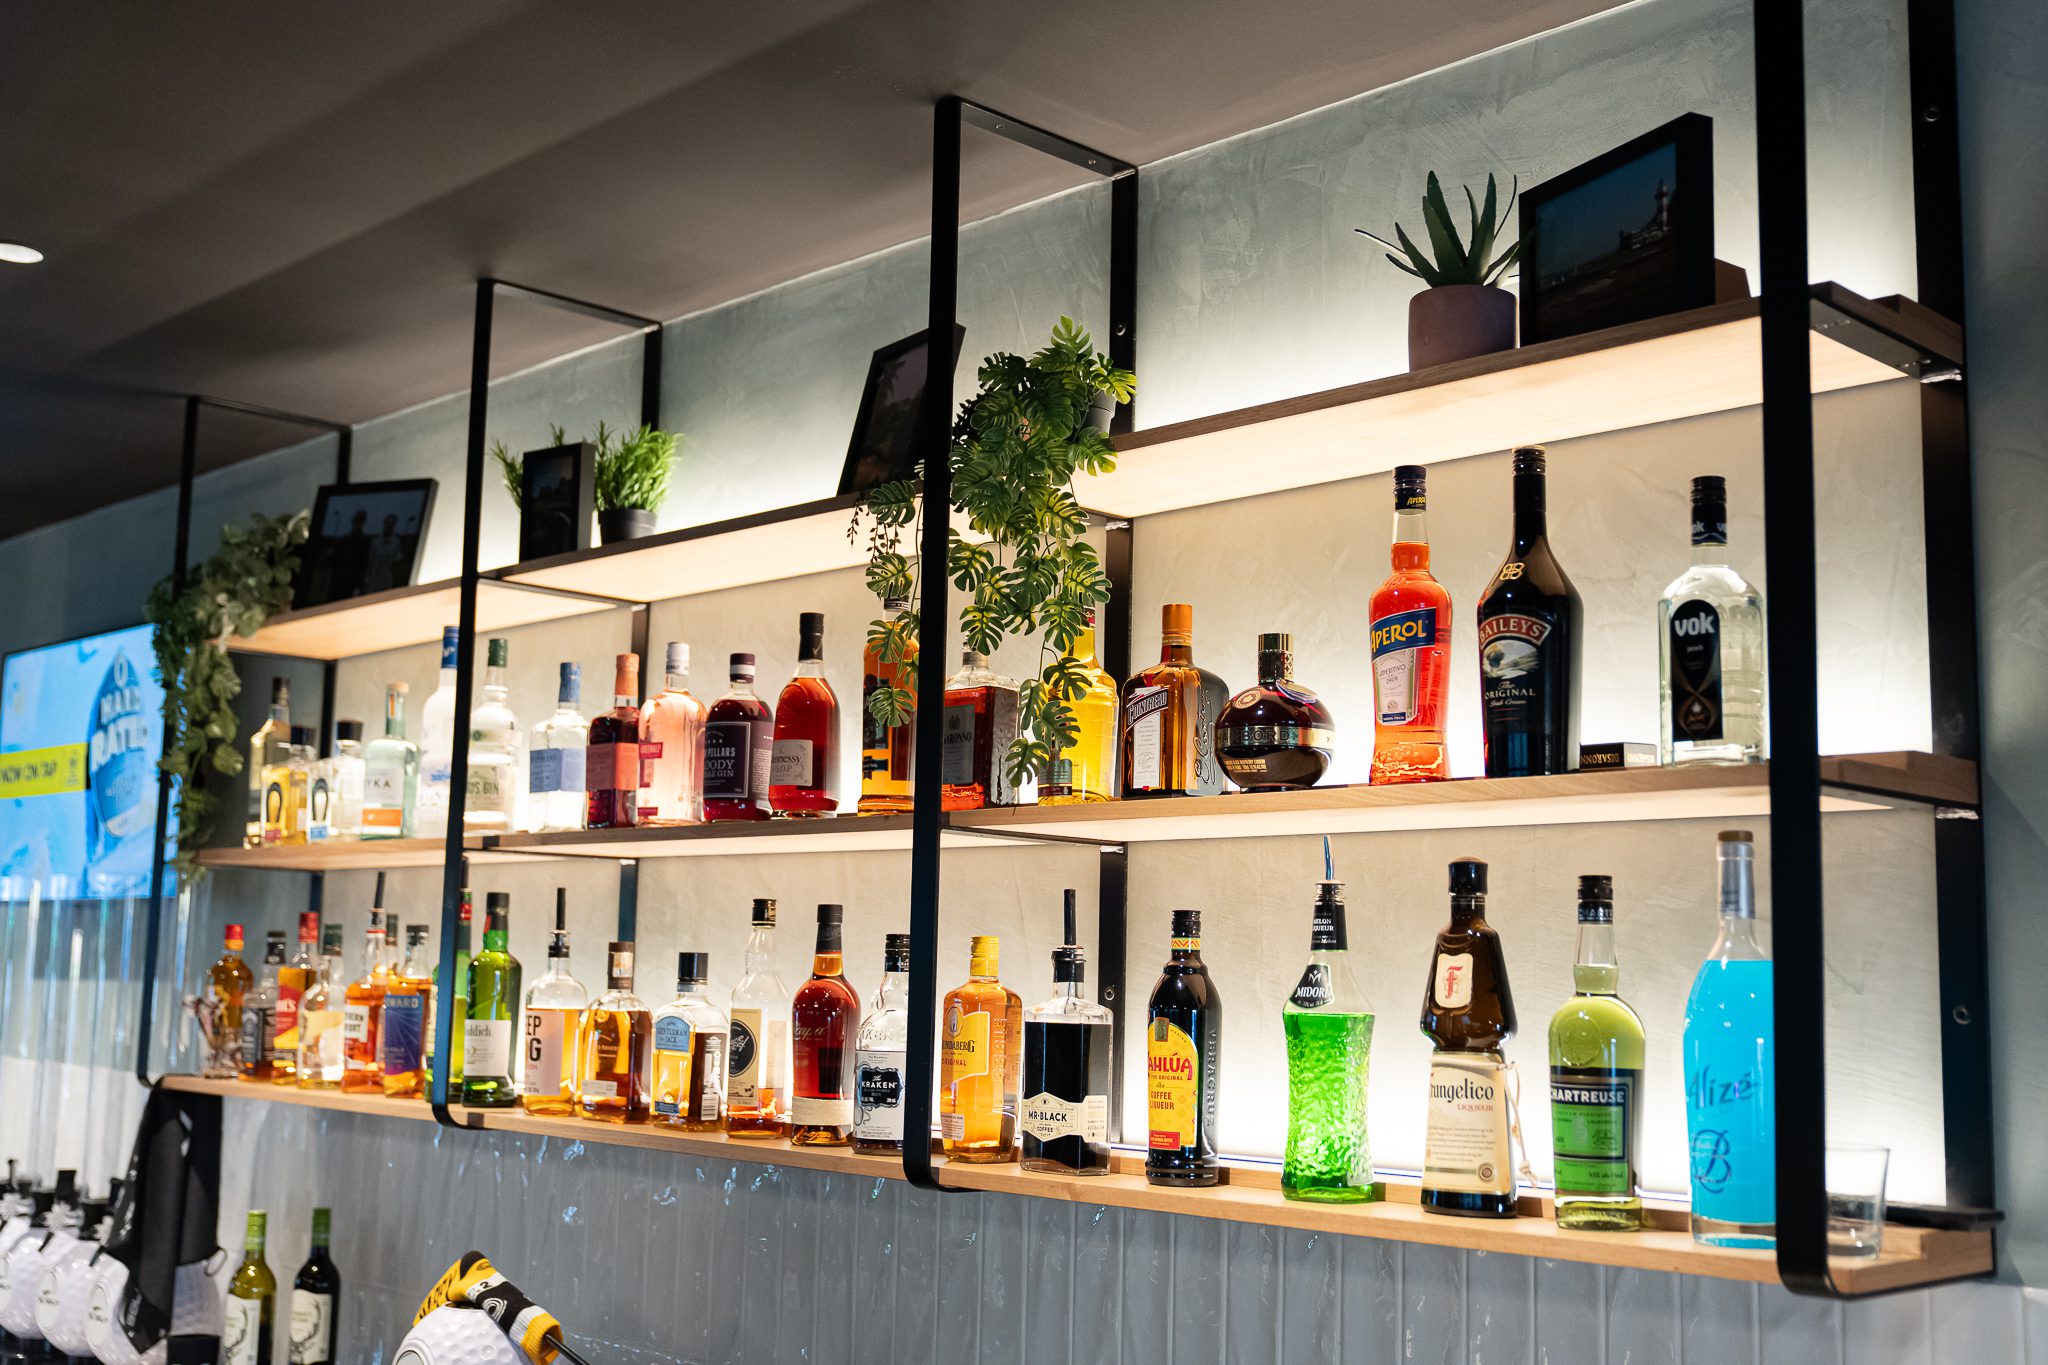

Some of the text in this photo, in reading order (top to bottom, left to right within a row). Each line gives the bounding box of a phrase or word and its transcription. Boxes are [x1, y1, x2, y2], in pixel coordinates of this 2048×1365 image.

[1370, 619, 1427, 653] APEROL
[1480, 618, 1541, 642] BAILEYS
[1485, 688, 1536, 700] ORIGINAL
[1127, 691, 1168, 726] COINTREAU
[483, 781, 499, 795] GIN
[1148, 1052, 1193, 1081] AHLÚA
[861, 1081, 895, 1089] KRAKEN
[1151, 1091, 1172, 1101] COFFEE
